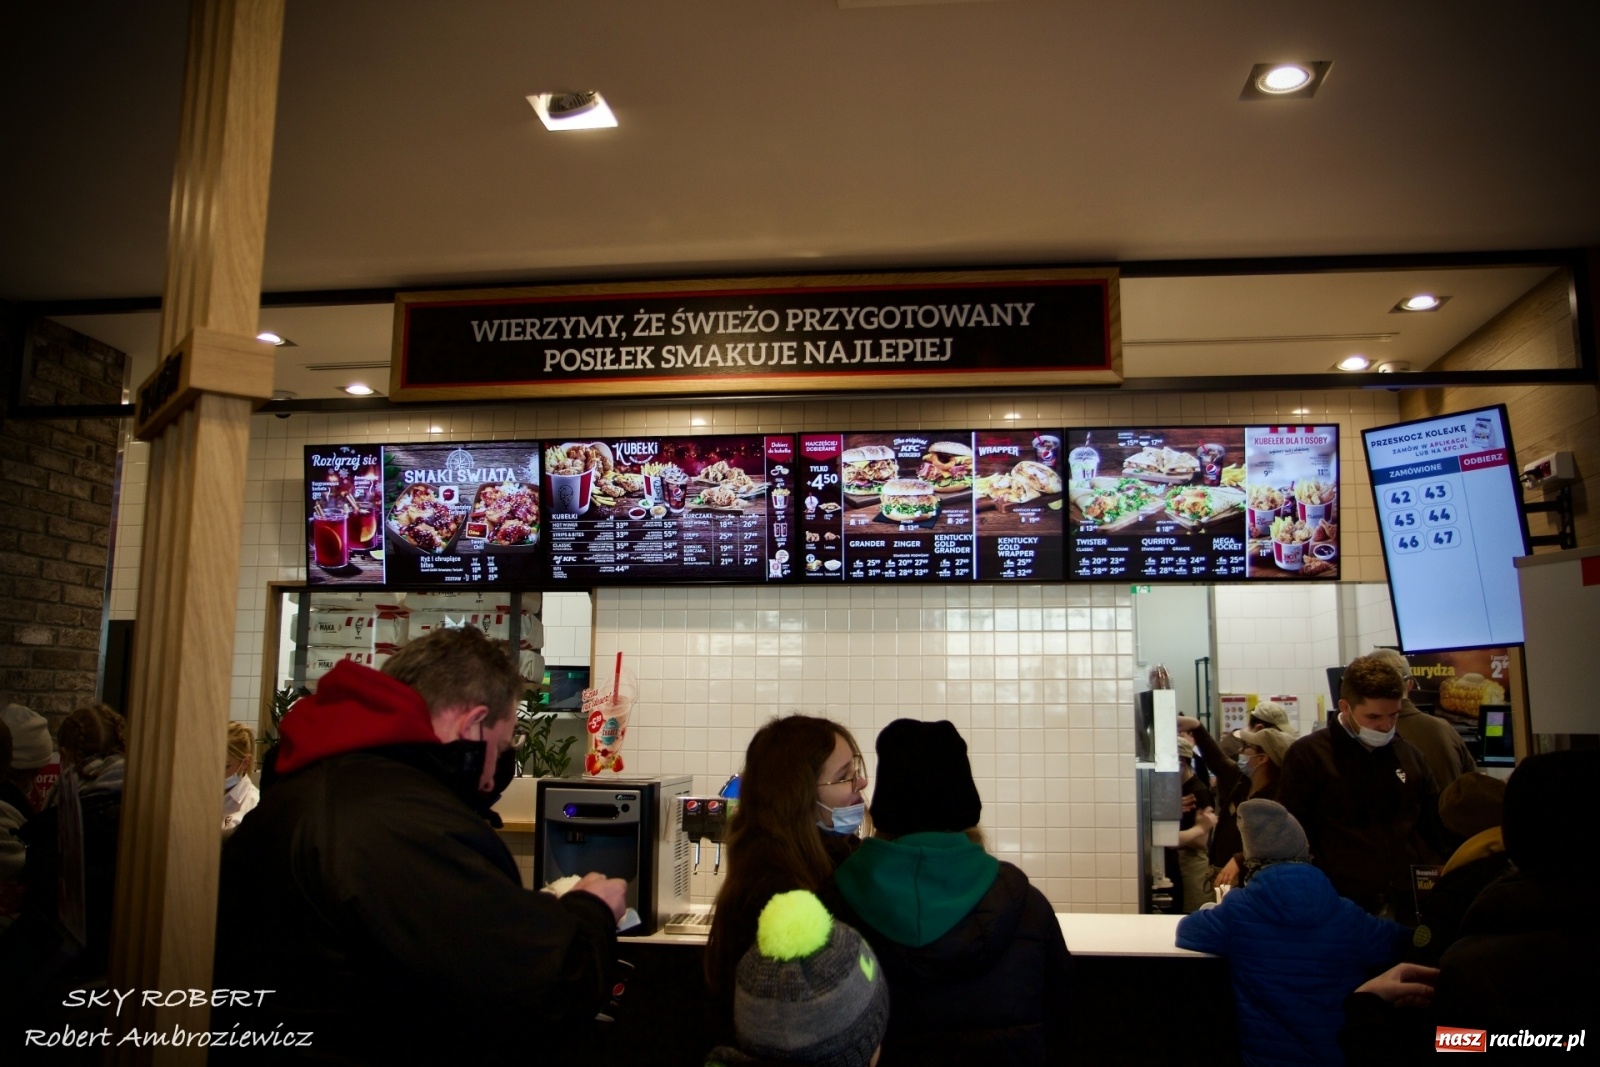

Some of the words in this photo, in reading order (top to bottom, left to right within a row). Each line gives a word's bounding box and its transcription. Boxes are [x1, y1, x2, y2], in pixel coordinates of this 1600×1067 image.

[471, 314, 628, 342] WIERZYMY,
[634, 309, 665, 337] ŻE
[672, 303, 779, 336] ŚWIEŻO
[786, 302, 1035, 332] PRZYGOTOWANY
[543, 347, 654, 372] POSIŁEK
[661, 341, 798, 370] SMAKUJE
[804, 337, 954, 365] NAJLEPIEJ
[1254, 437, 1284, 446] KUBEŁEK
[1286, 437, 1299, 445] DLA
[1304, 436, 1328, 445] OSOBY
[1371, 431, 1423, 447] PRZESKOCZ
[1425, 424, 1466, 439] KOLEJKĘ
[978, 446, 1020, 457] WRAPPER
[1392, 444, 1419, 455] ZAMÓW
[1429, 437, 1468, 449] APLIKACJI
[1415, 449, 1429, 457] LUB
[1443, 444, 1469, 454] KFC.PL
[1389, 462, 1442, 478] ZAMÓWIONE
[1463, 453, 1503, 466] ODBIERZ
[405, 469, 453, 484] SMAKI
[1391, 491, 1411, 504] 42
[1425, 485, 1446, 499] 43
[1395, 513, 1415, 527] 45
[1429, 508, 1450, 522] 44
[934, 534, 974, 542] KENTUCKY
[1076, 538, 1107, 546] TWISTER
[1142, 538, 1175, 546] QURRITO
[1399, 535, 1419, 549] 46
[1433, 530, 1453, 544] 47
